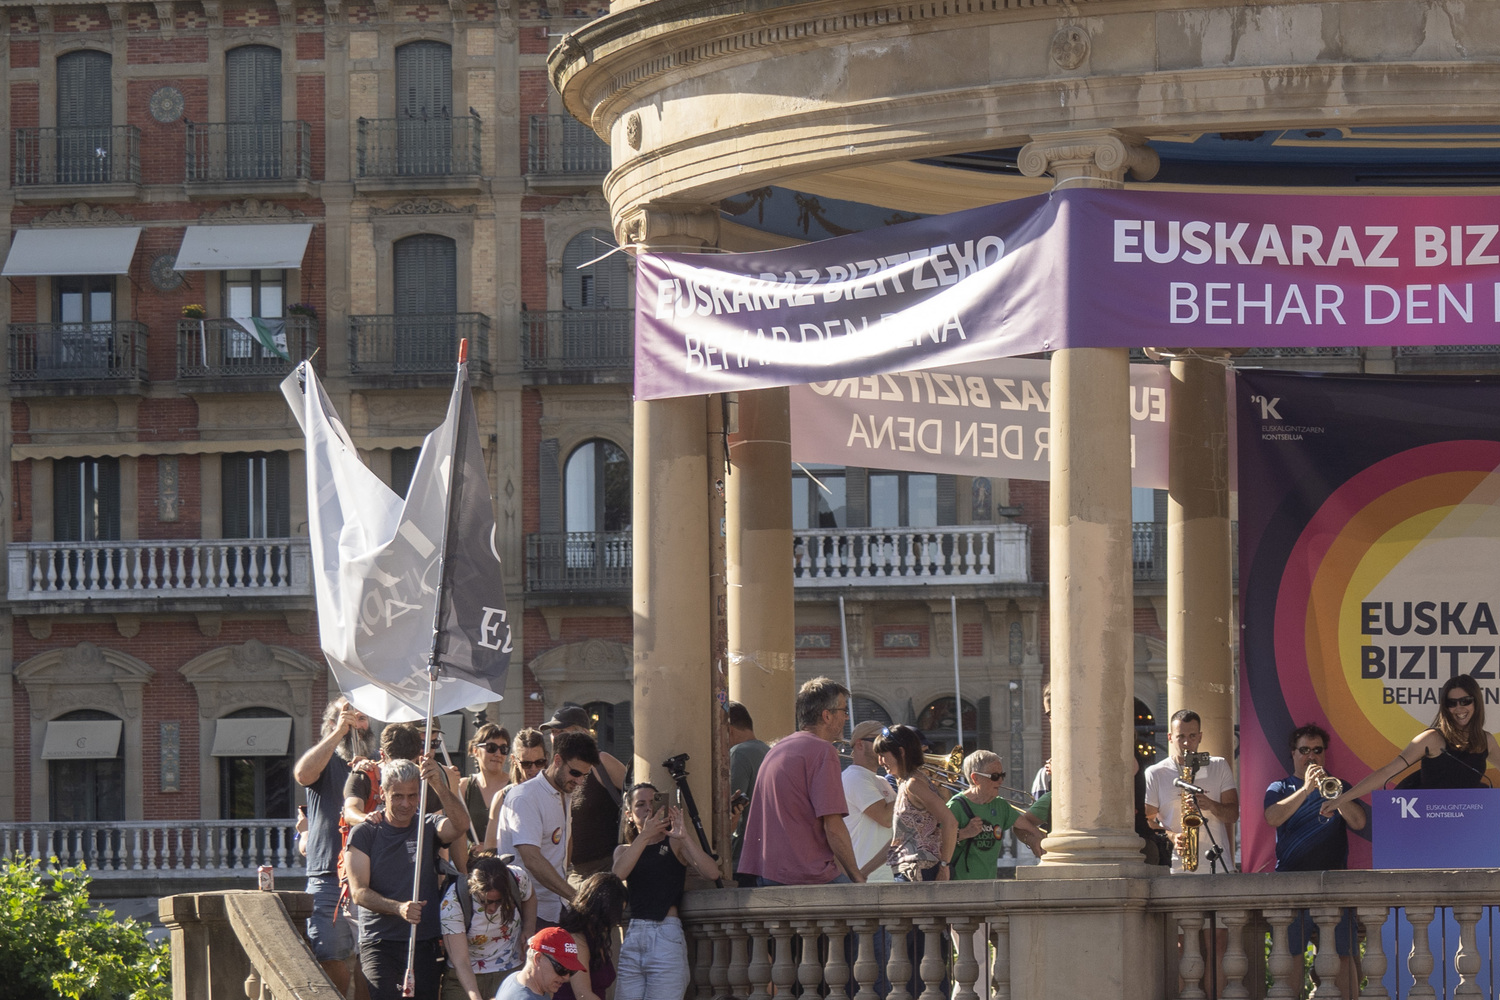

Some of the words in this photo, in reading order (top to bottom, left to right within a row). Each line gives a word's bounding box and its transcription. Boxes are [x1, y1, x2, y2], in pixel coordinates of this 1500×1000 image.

[1113, 219, 1400, 269] EUSKARAZ
[655, 268, 819, 321] EUSKARAZ
[822, 235, 1006, 304] BIZITZEKO
[1169, 281, 1348, 326] BEHAR
[1364, 283, 1474, 325] DEN
[1261, 433, 1304, 441] KONTSEILUA
[1425, 803, 1484, 811] EUSKALGINTZAREN
